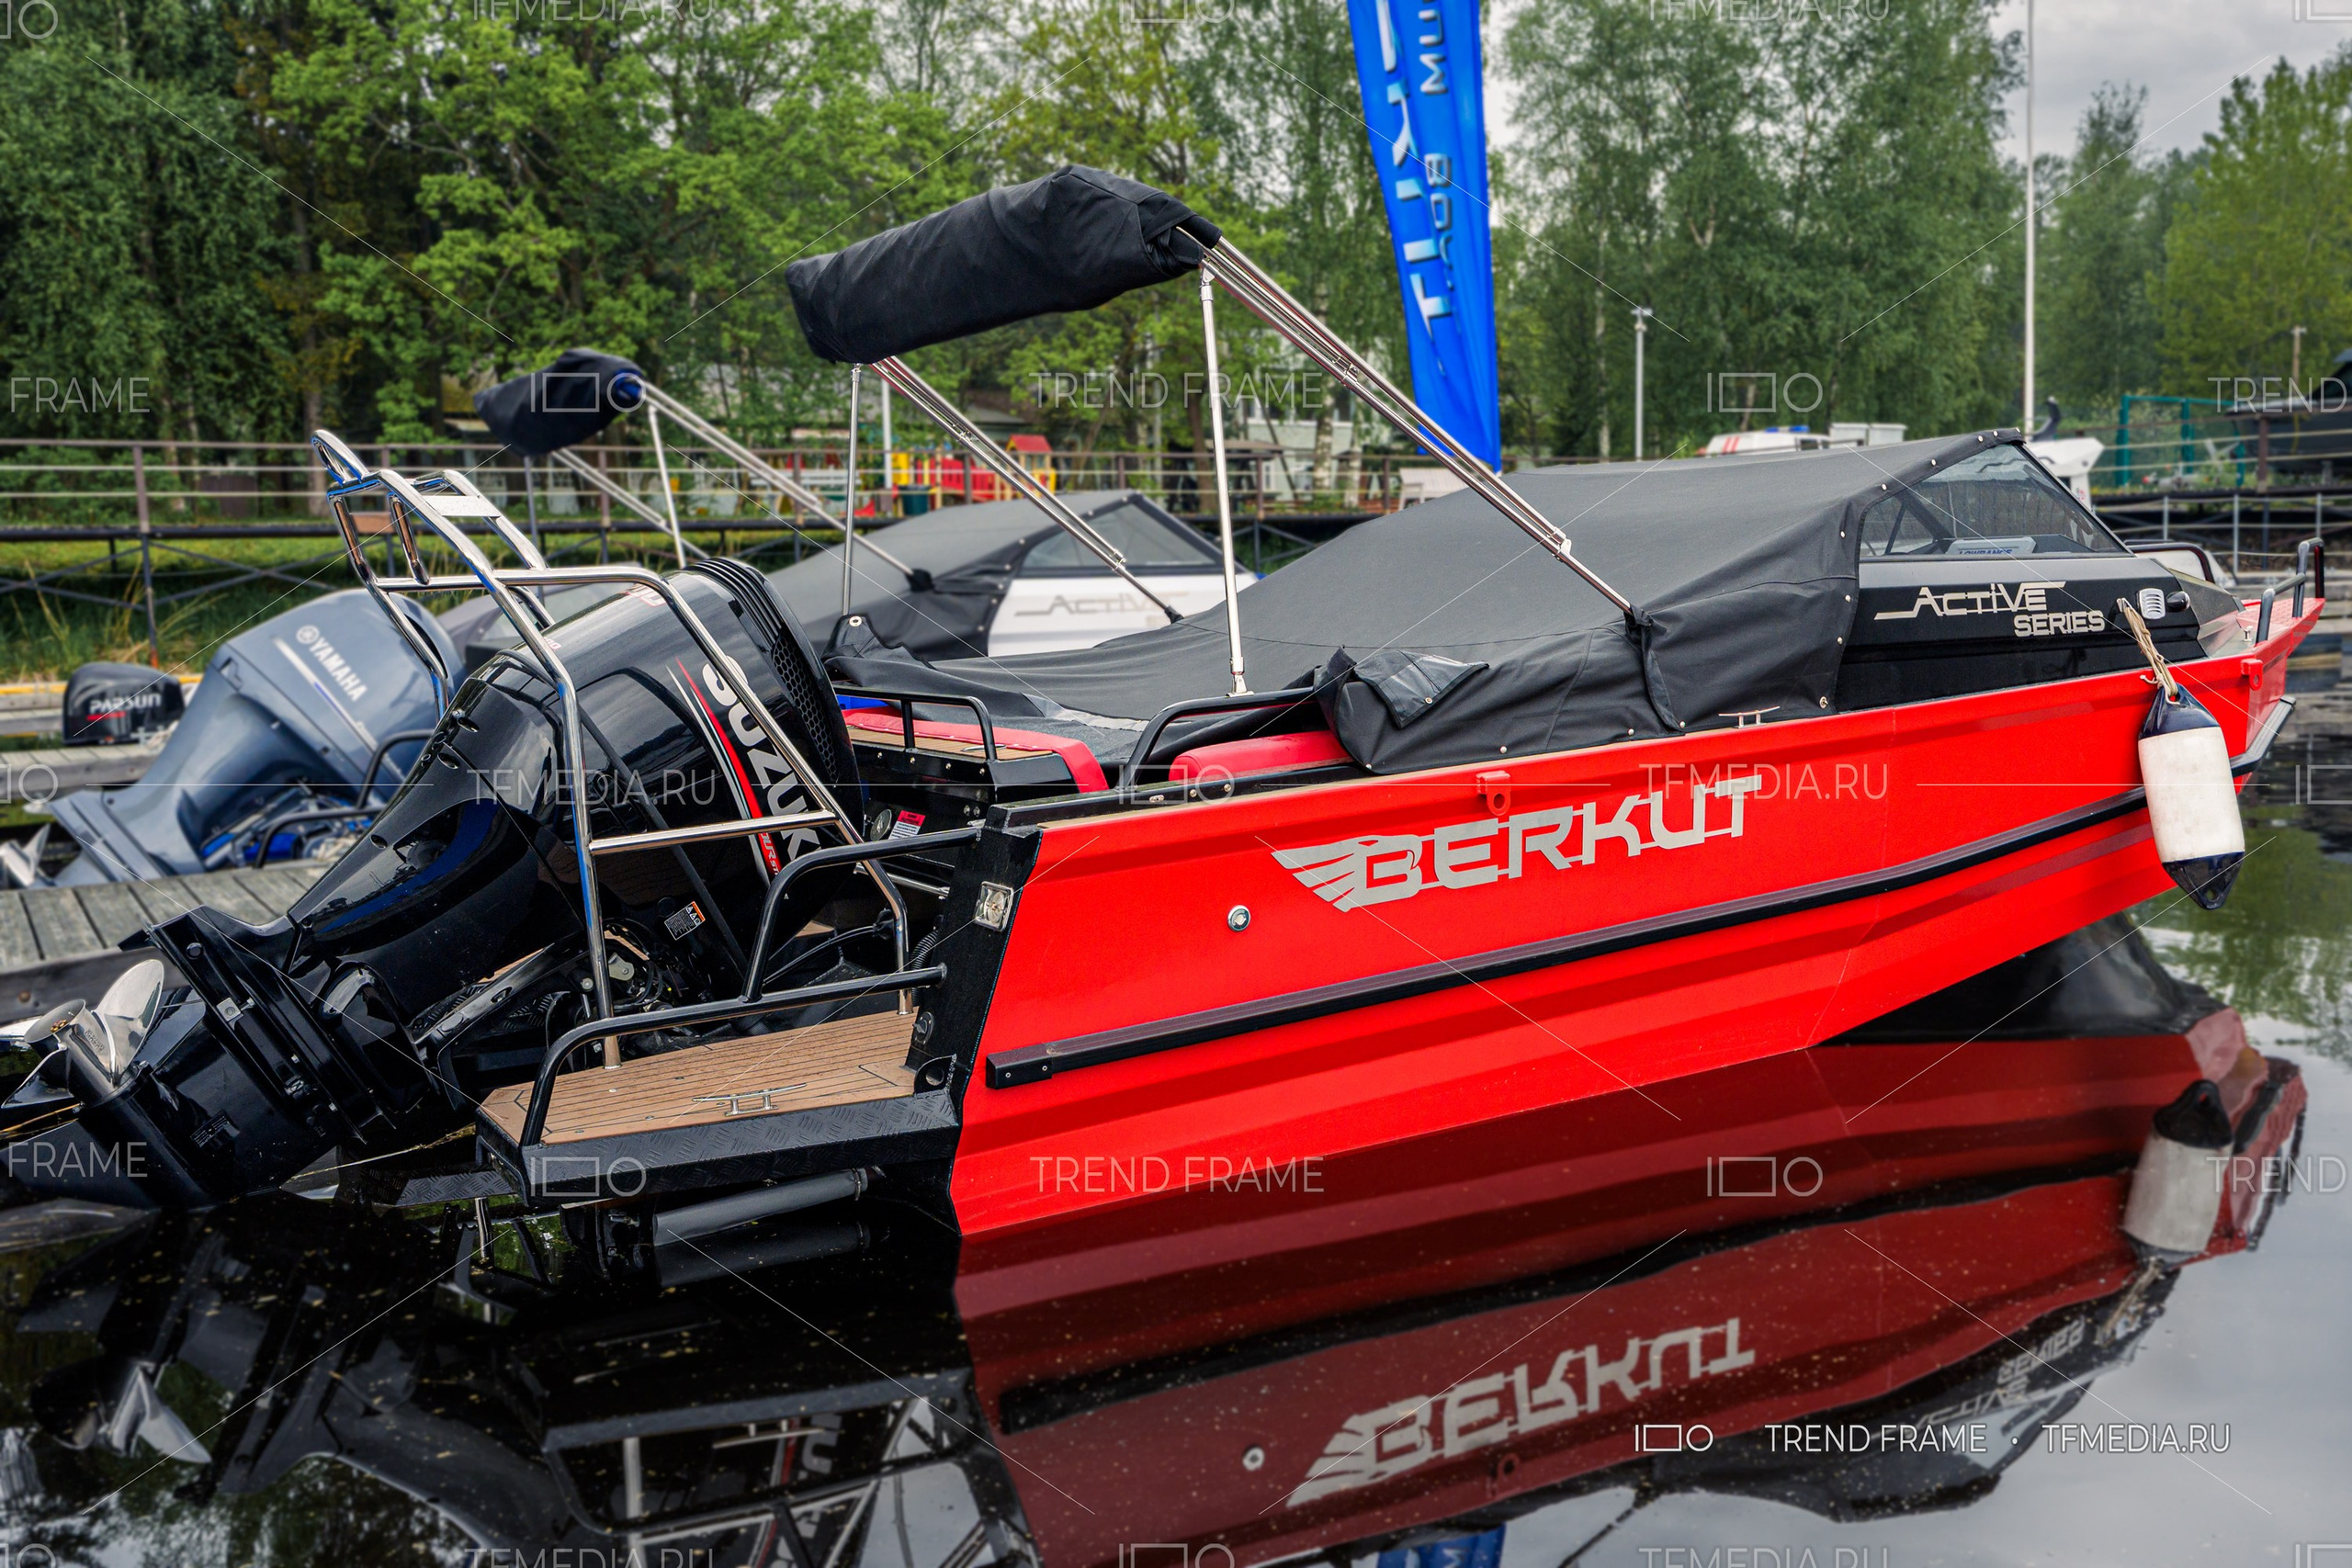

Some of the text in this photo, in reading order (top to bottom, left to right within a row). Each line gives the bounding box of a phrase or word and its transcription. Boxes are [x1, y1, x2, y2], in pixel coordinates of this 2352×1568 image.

[2013, 609, 2106, 637] SERIES
[309, 636, 368, 702] YAMAHA
[1323, 773, 1762, 912] BERKUT
